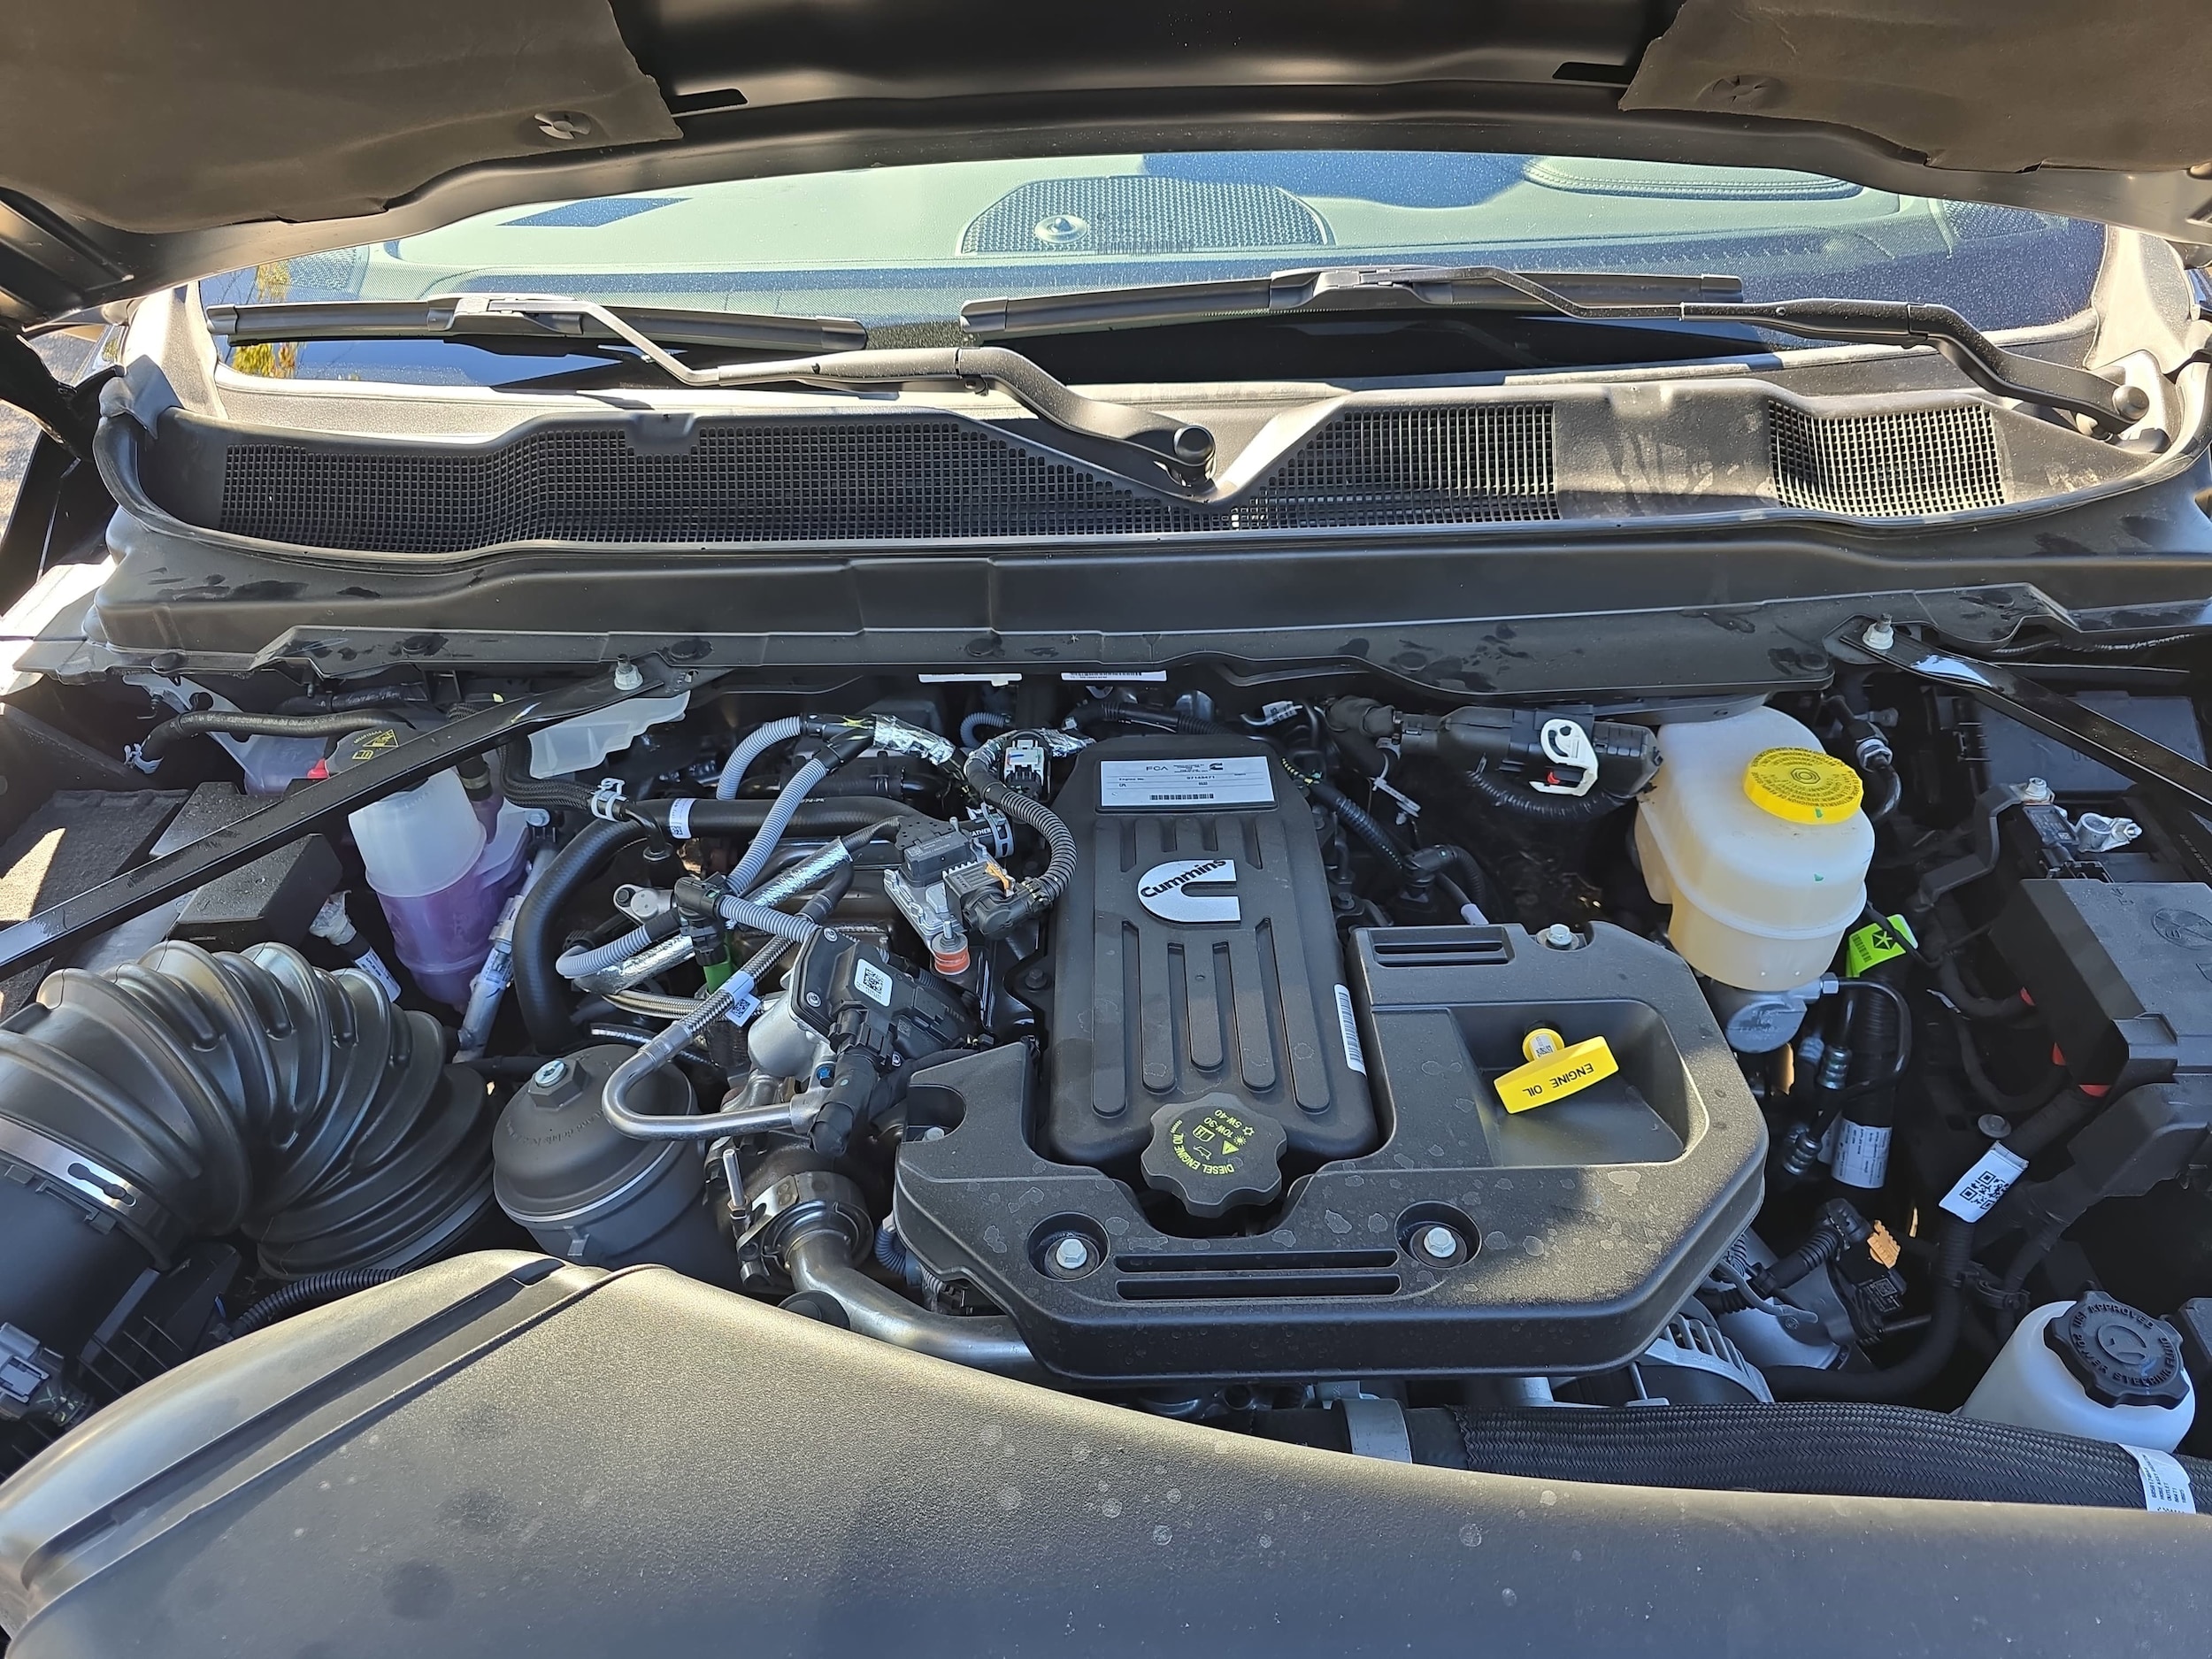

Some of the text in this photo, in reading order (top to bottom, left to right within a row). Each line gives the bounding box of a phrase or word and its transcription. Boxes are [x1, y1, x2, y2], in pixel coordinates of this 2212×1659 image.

[1140, 860, 1227, 898] Cummins
[1522, 1063, 1594, 1097] ENGINE OIL
[1203, 1117, 1234, 1138] 10W-30
[1214, 1109, 1243, 1129] 5W-40
[1172, 1133, 1235, 1175] DIESEL ENGINE OIL
[2088, 1302, 2155, 1329] APPROVED
[2072, 1333, 2108, 1372] POWER
[2159, 1335, 2177, 1370] FLUID
[2113, 1368, 2172, 1387] STEERING
